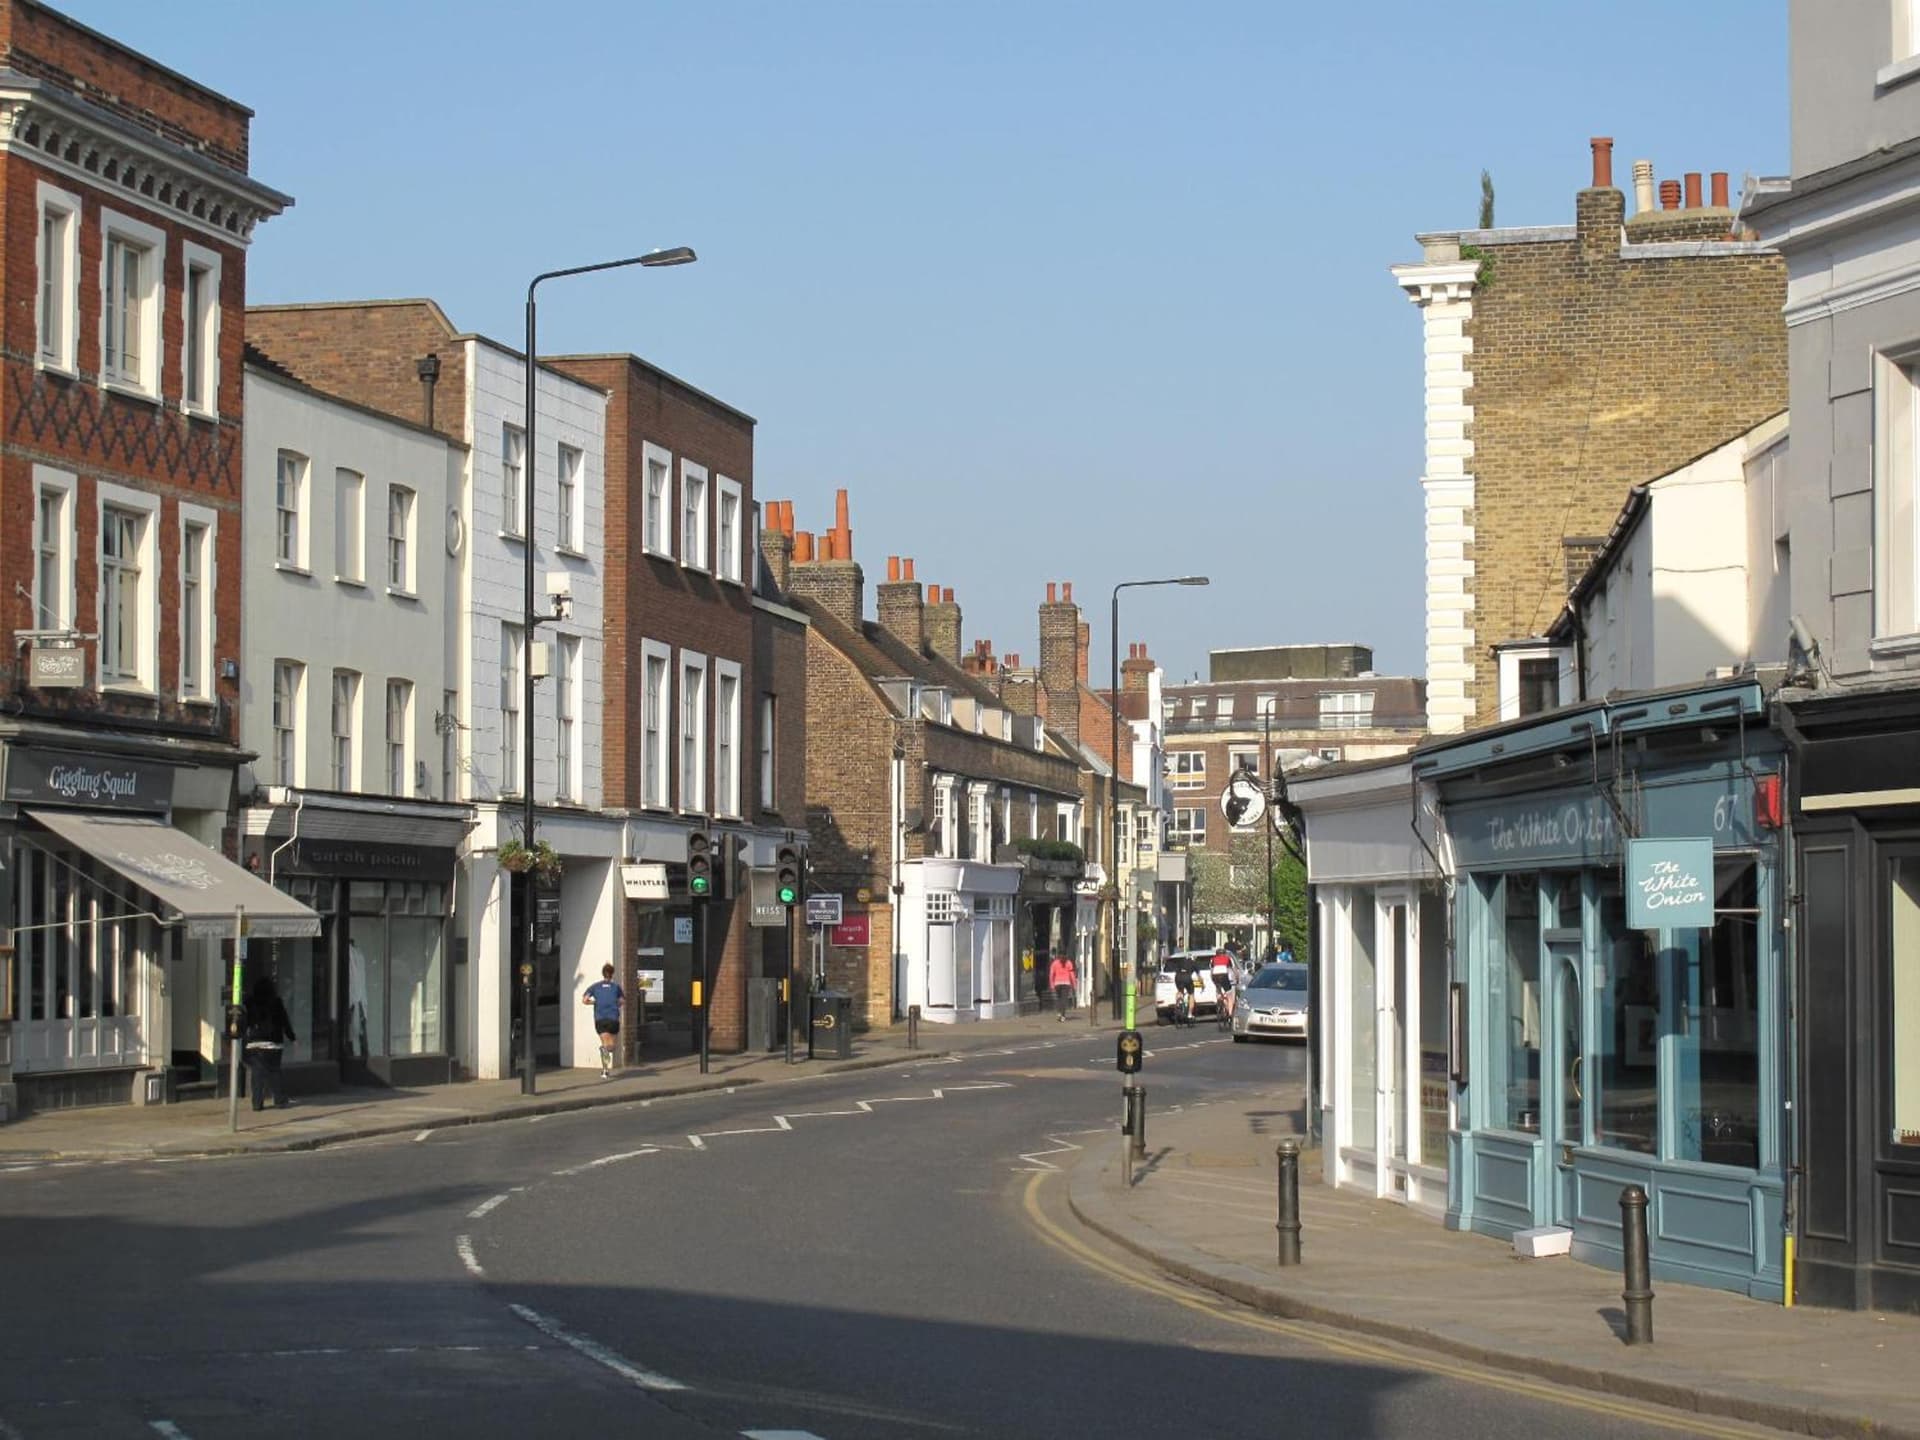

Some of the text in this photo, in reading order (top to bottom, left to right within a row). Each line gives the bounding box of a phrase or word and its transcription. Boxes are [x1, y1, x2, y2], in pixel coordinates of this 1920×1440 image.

[49, 765, 137, 801] Giggling Squid
[1713, 794, 1738, 832] 67
[1487, 807, 1615, 851] The White Onion
[1637, 871, 1699, 893] White
[1650, 860, 1681, 875] The
[1645, 890, 1707, 910] Onion
